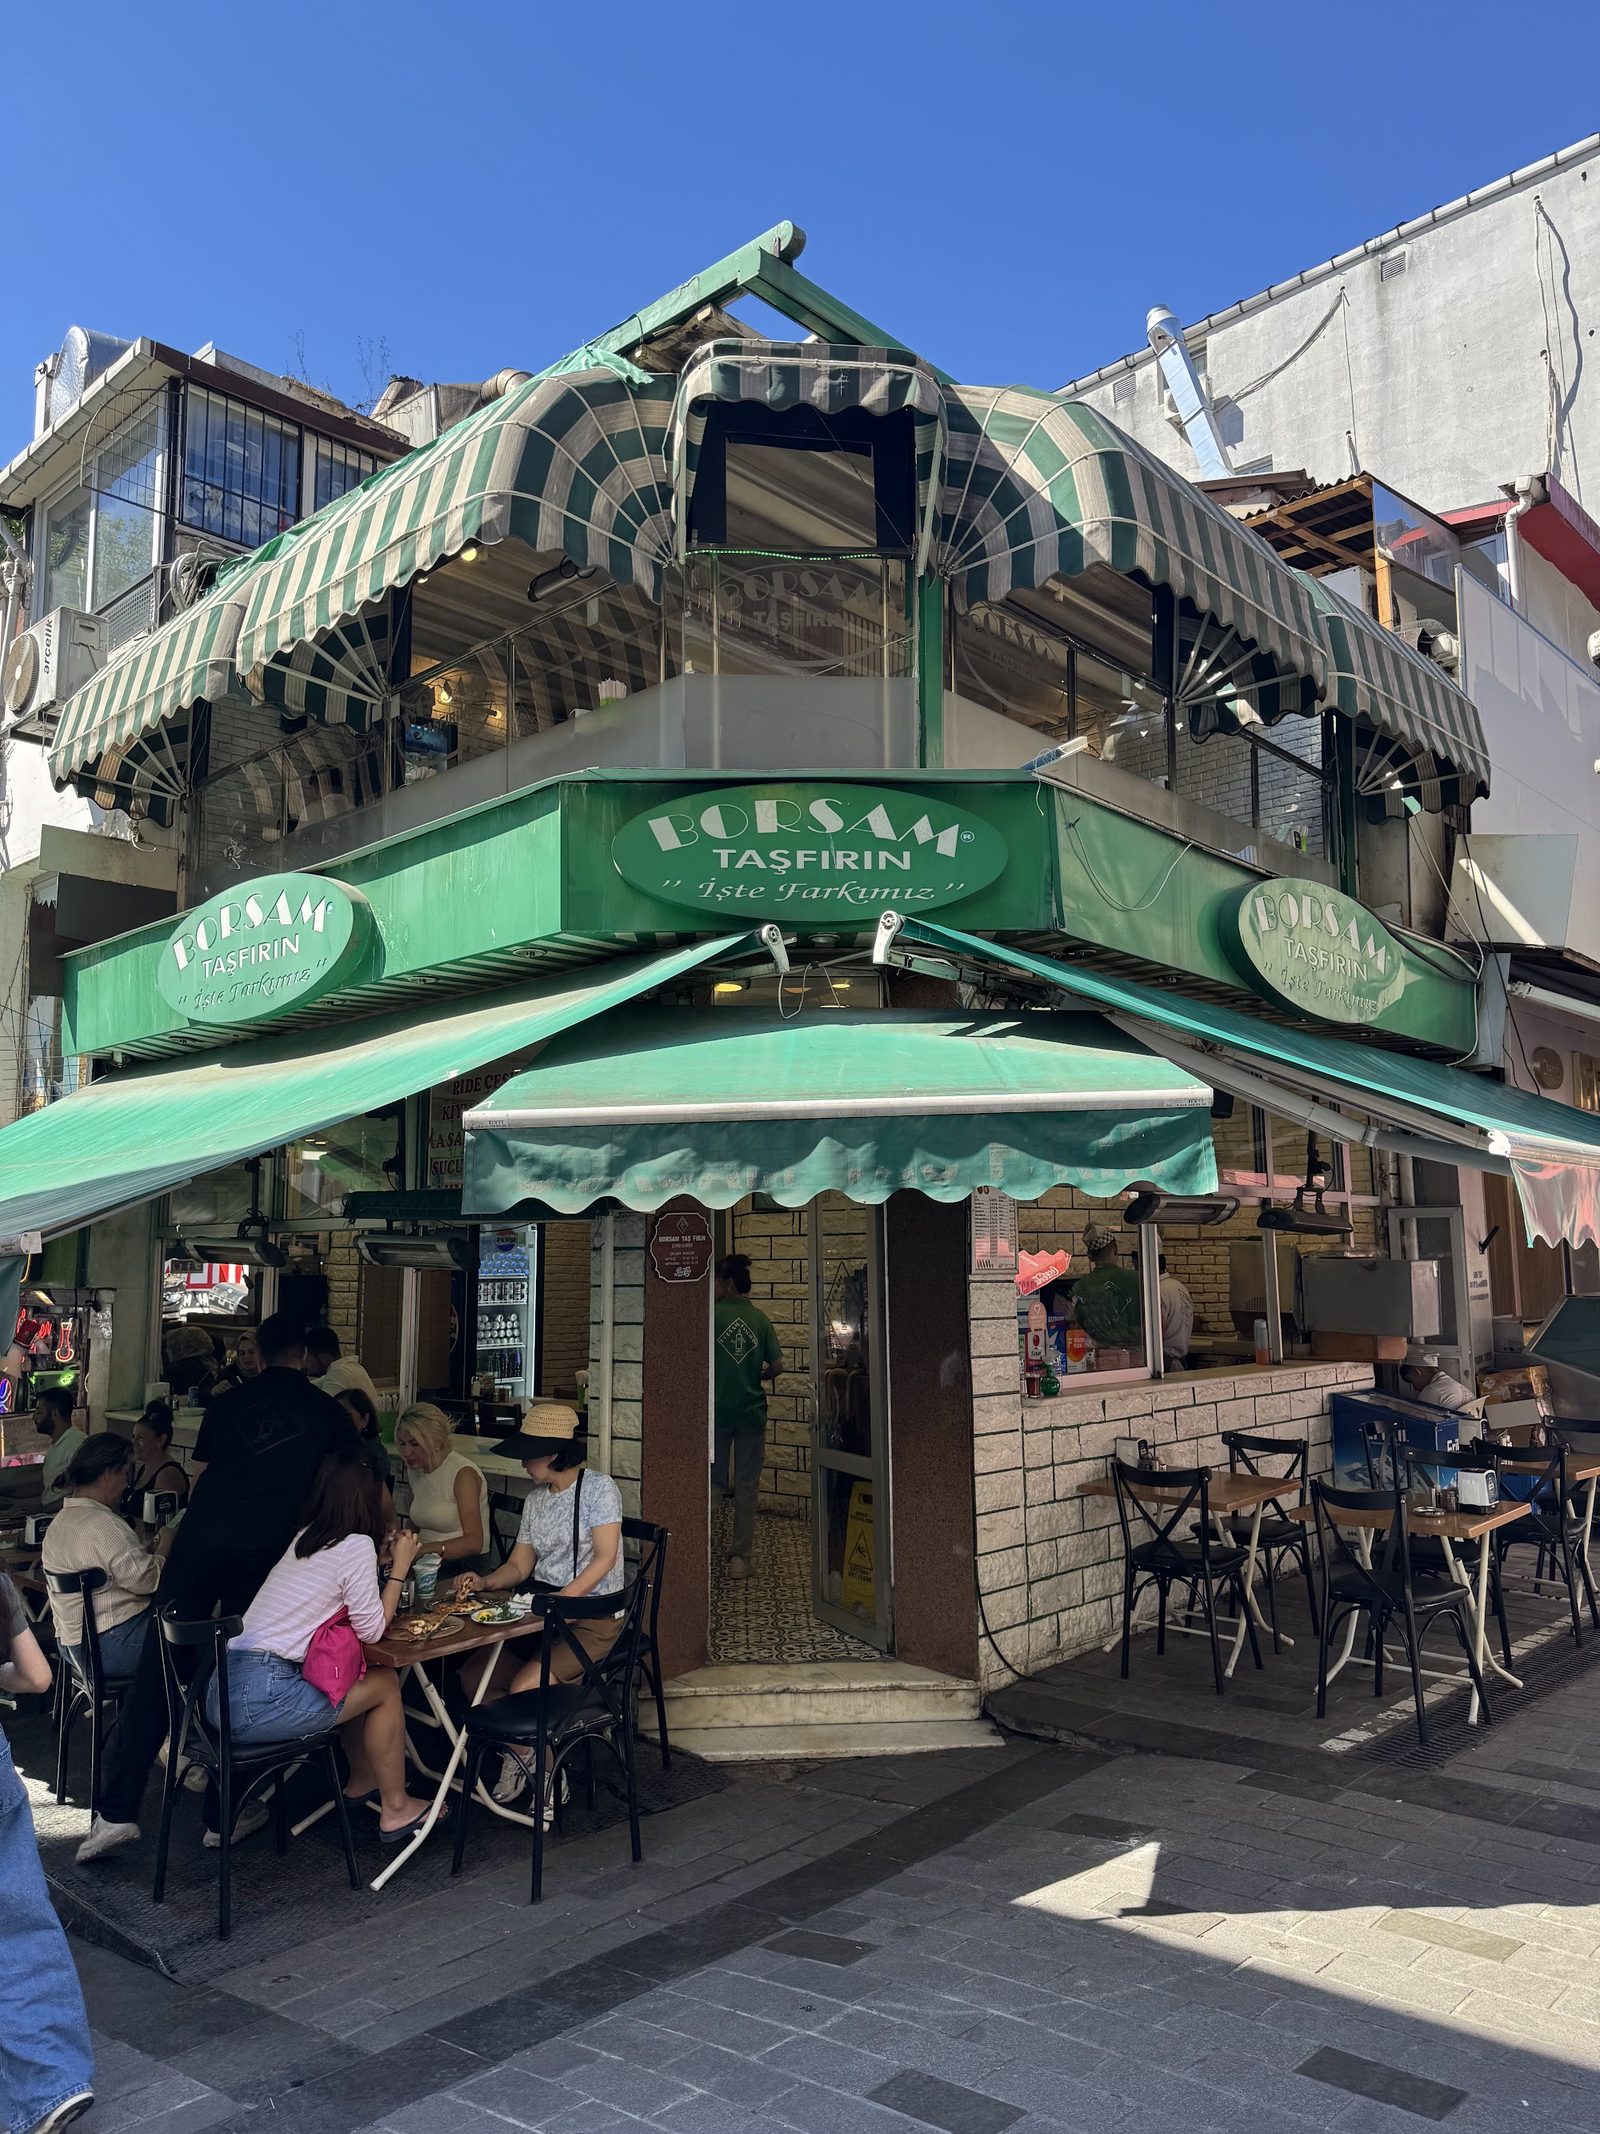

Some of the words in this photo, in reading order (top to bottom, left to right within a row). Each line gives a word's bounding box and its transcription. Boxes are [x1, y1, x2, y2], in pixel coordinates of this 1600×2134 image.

[43, 618, 53, 675] arçelik
[647, 798, 959, 858] BORSAM
[712, 848, 911, 875] TAŞFIRIN
[699, 877, 766, 902] İşte
[775, 880, 936, 904] Farkımız
[172, 888, 327, 971] BORSAM
[1254, 892, 1388, 975] BORSAM
[201, 933, 301, 979] TAŞFIRIN
[1284, 937, 1368, 981] TAŞFIRIN
